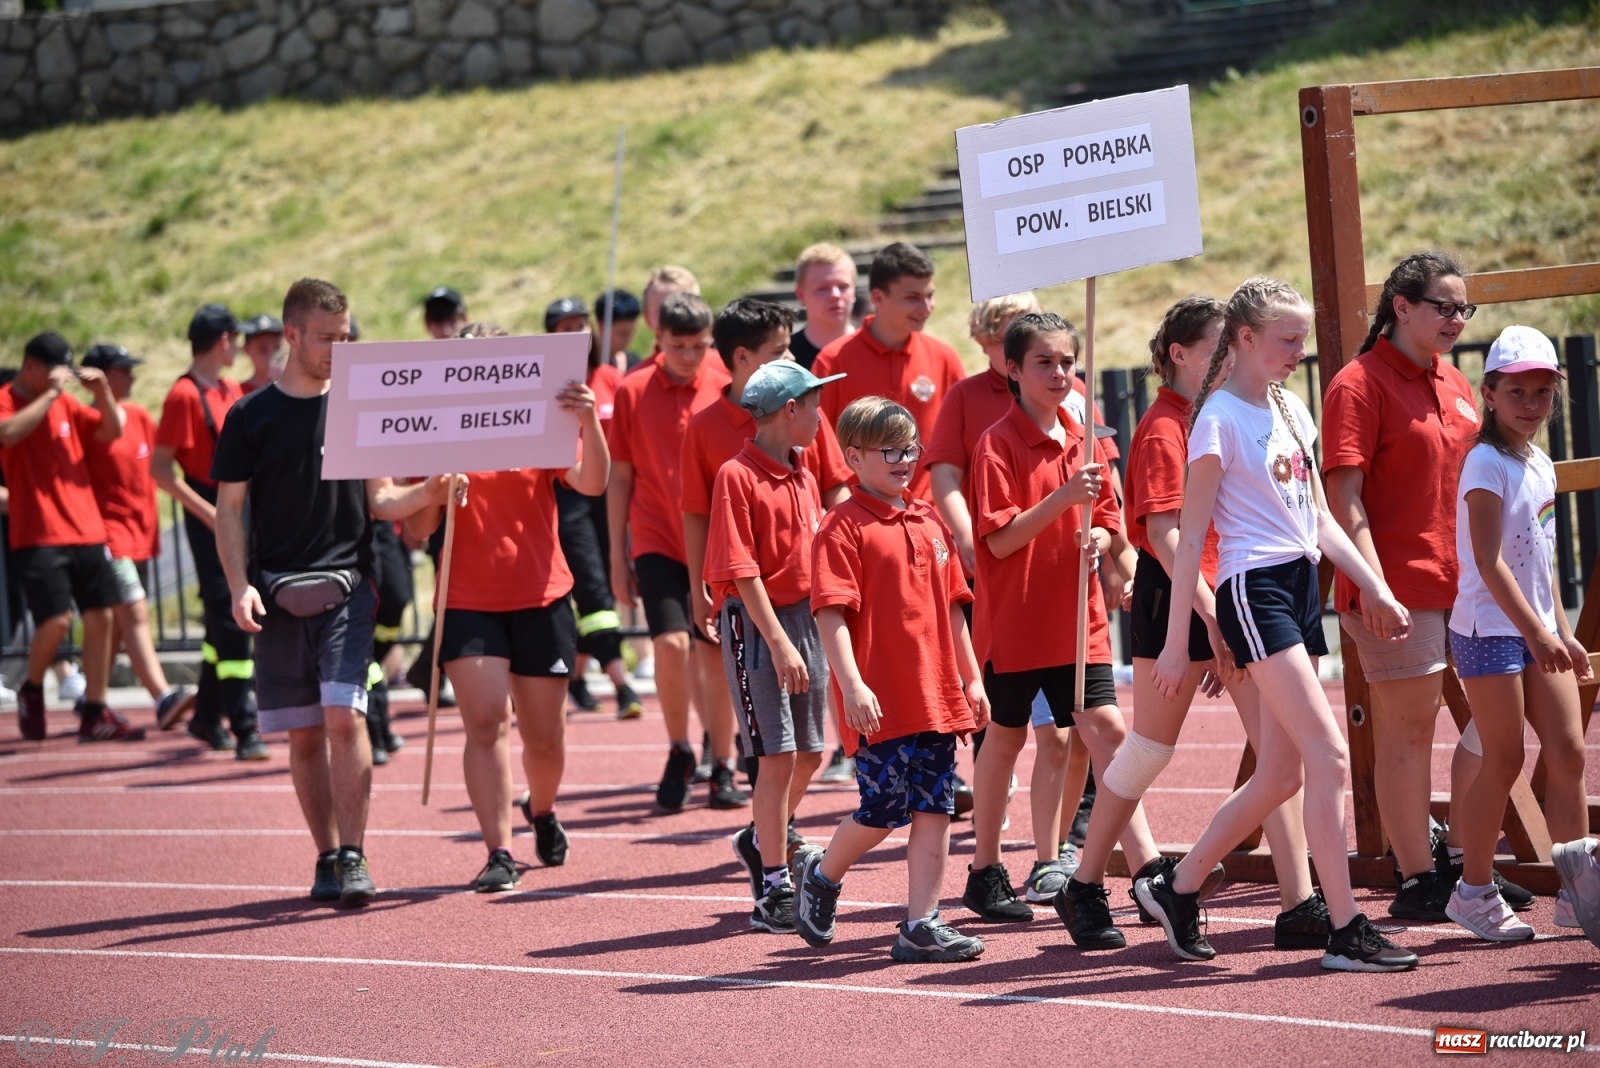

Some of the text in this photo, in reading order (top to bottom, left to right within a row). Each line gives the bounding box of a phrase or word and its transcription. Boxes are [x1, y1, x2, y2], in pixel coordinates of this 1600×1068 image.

[1008, 133, 1152, 177] OSP PORĄBKA
[1016, 192, 1152, 236] POW. BIELSKI
[381, 362, 541, 386] OSP PORĄBKA
[381, 408, 532, 434] POW. BIELSKI
[1401, 877, 1419, 890] PUMA
